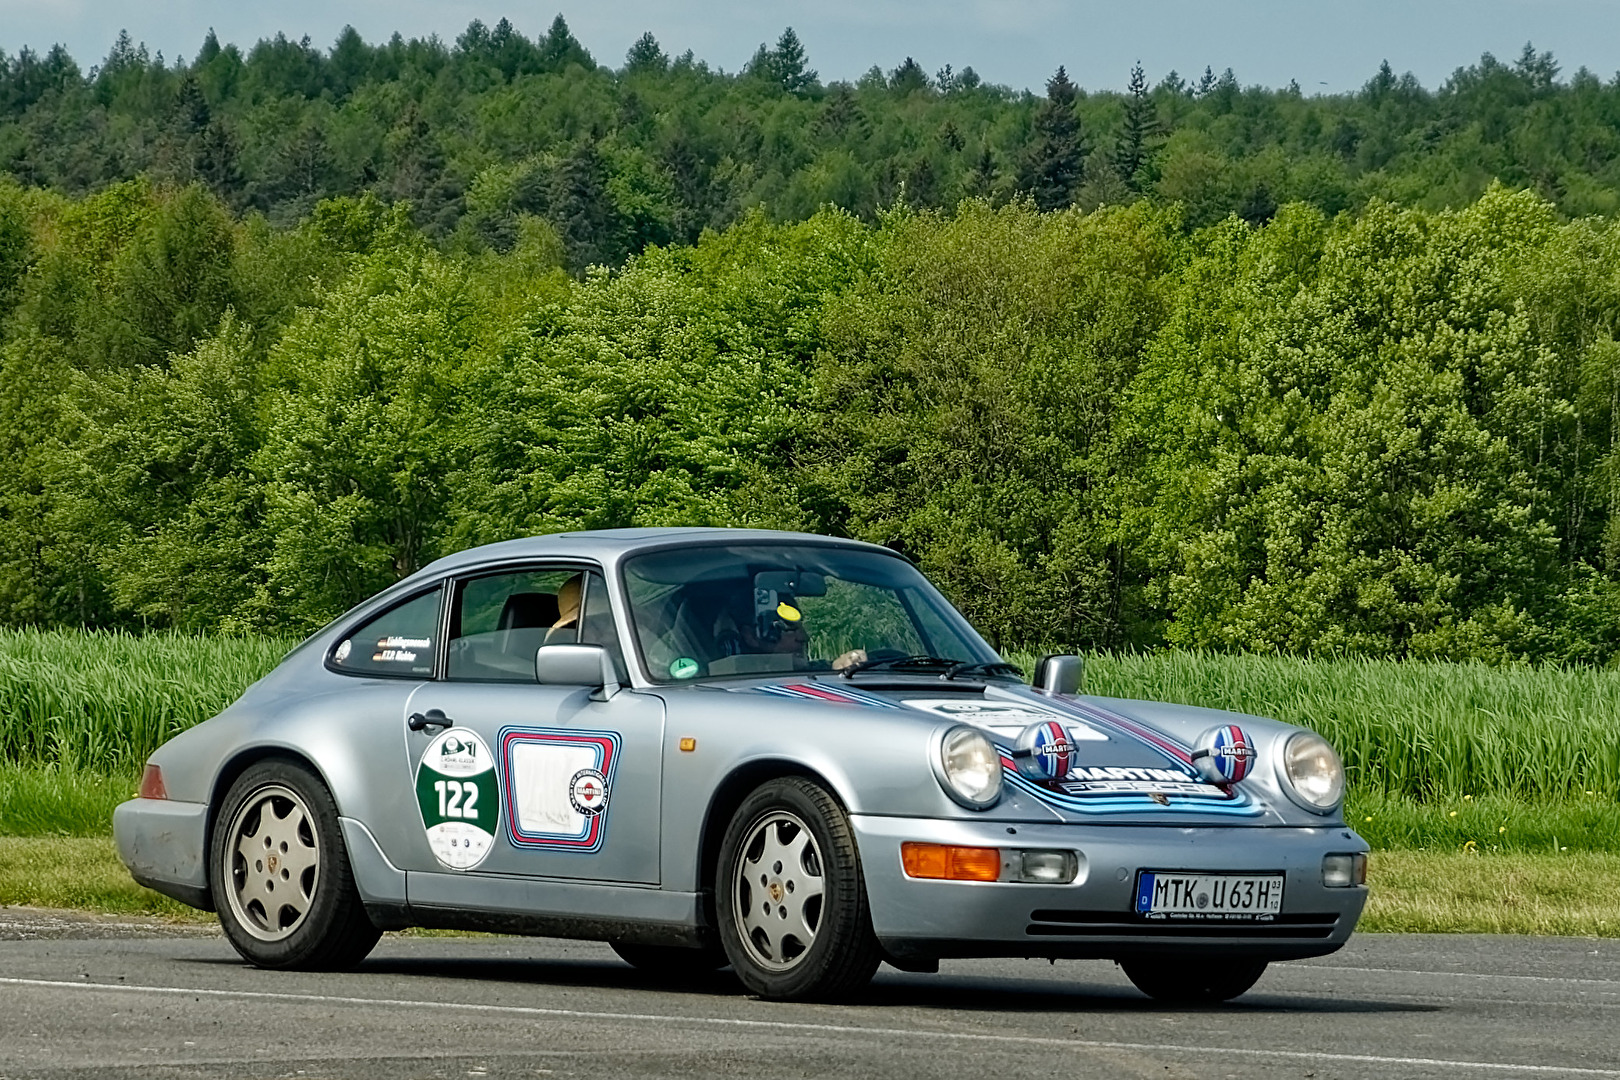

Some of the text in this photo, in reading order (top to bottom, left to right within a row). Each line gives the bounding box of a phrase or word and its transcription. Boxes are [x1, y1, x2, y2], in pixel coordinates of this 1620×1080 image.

[679, 660, 687, 668] 4
[1065, 767, 1193, 783] MARTINI
[577, 787, 601, 796] MARTINI
[434, 780, 479, 819] 122
[1271, 881, 1281, 889] 03
[1153, 879, 1270, 909] MTK U 63H
[1141, 896, 1148, 905] D
[1270, 901, 1278, 909] 10
